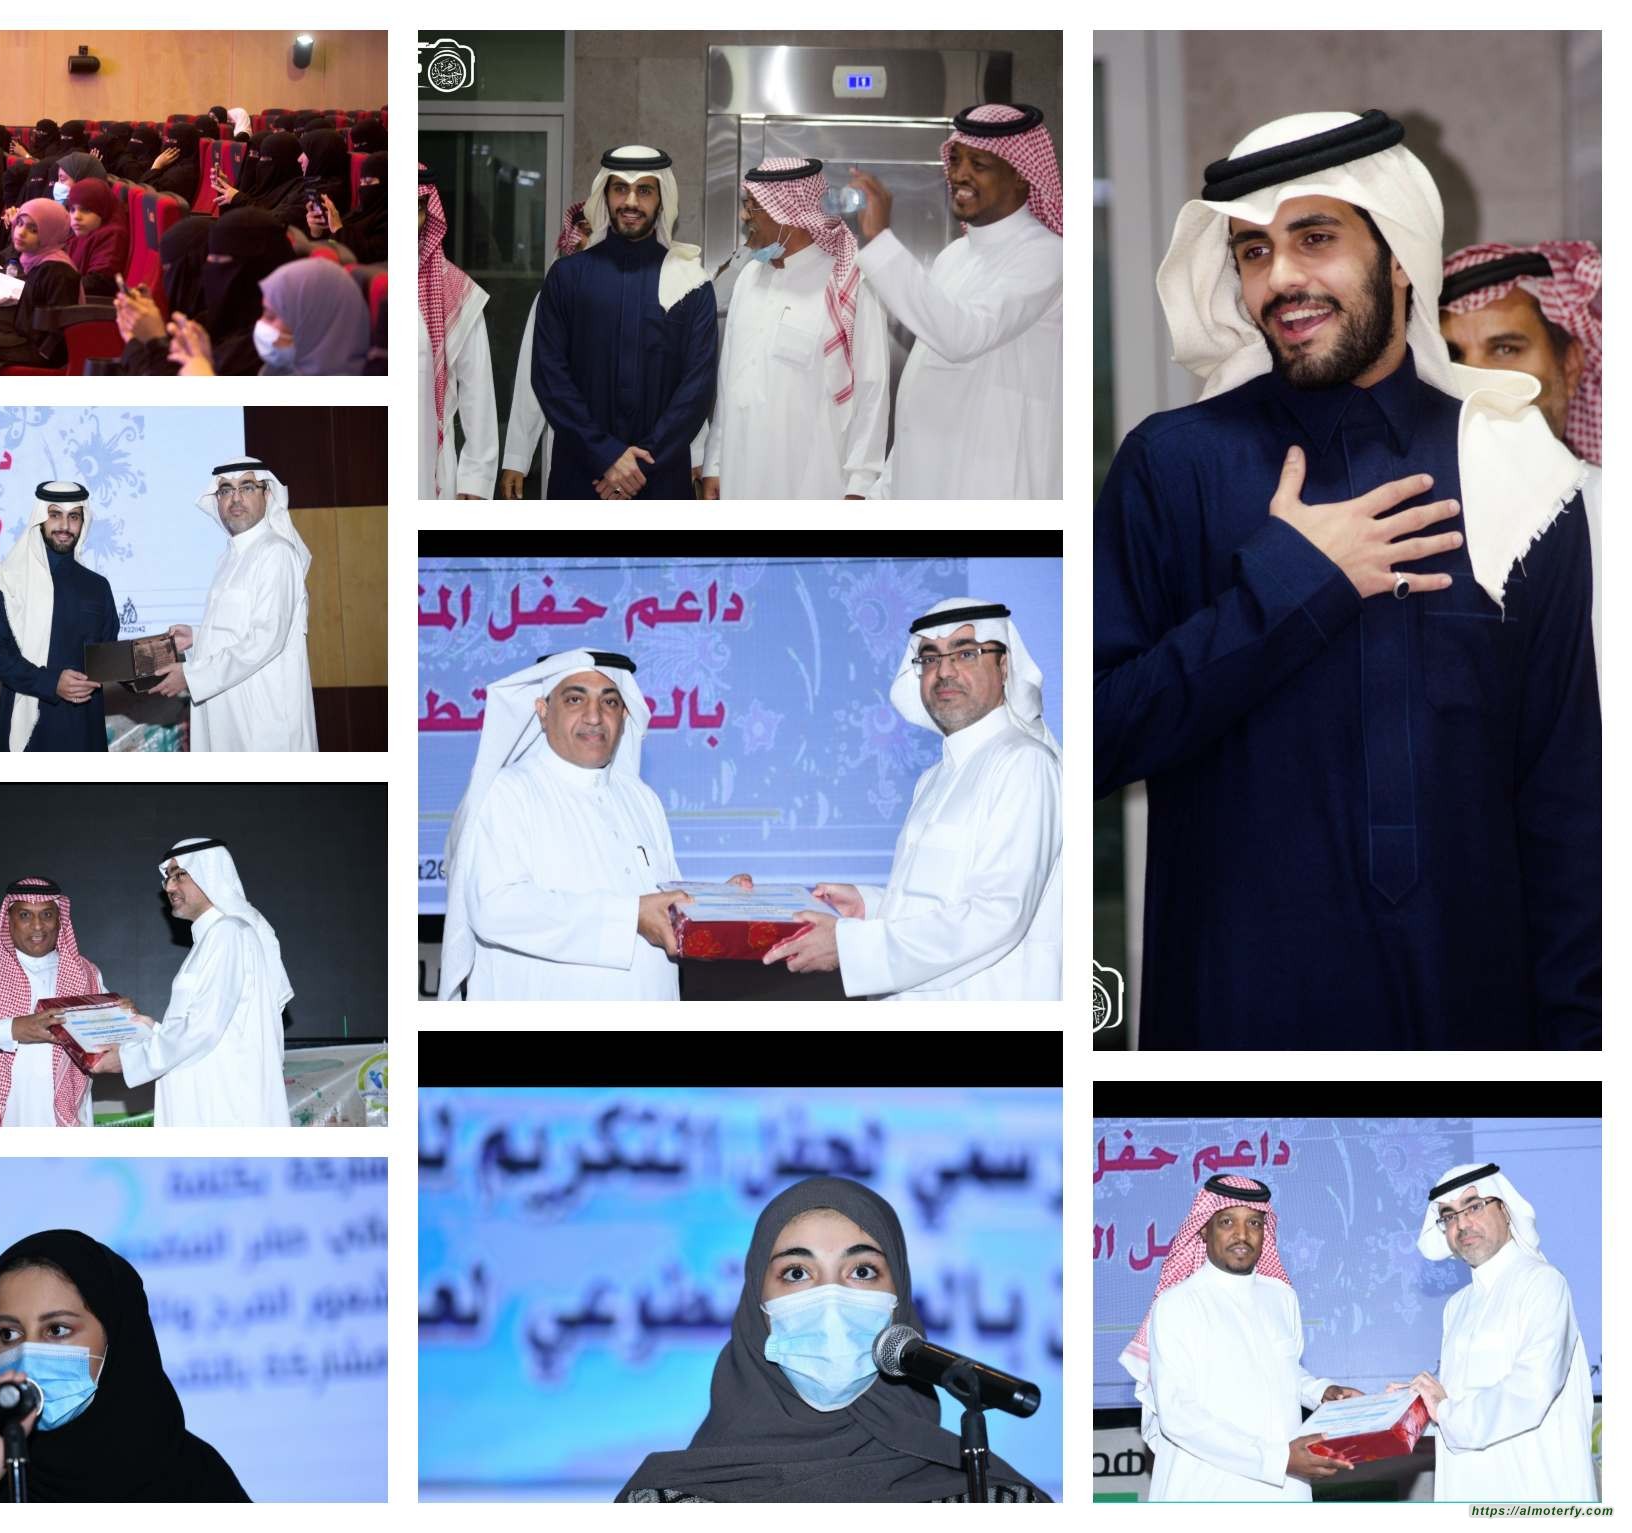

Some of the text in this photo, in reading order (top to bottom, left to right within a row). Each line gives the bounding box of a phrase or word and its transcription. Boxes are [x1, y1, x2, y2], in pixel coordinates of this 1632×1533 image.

[488, 575, 608, 642] حفل
[624, 579, 745, 643] داعم
[1093, 1128, 1291, 1185] داعم حفل
